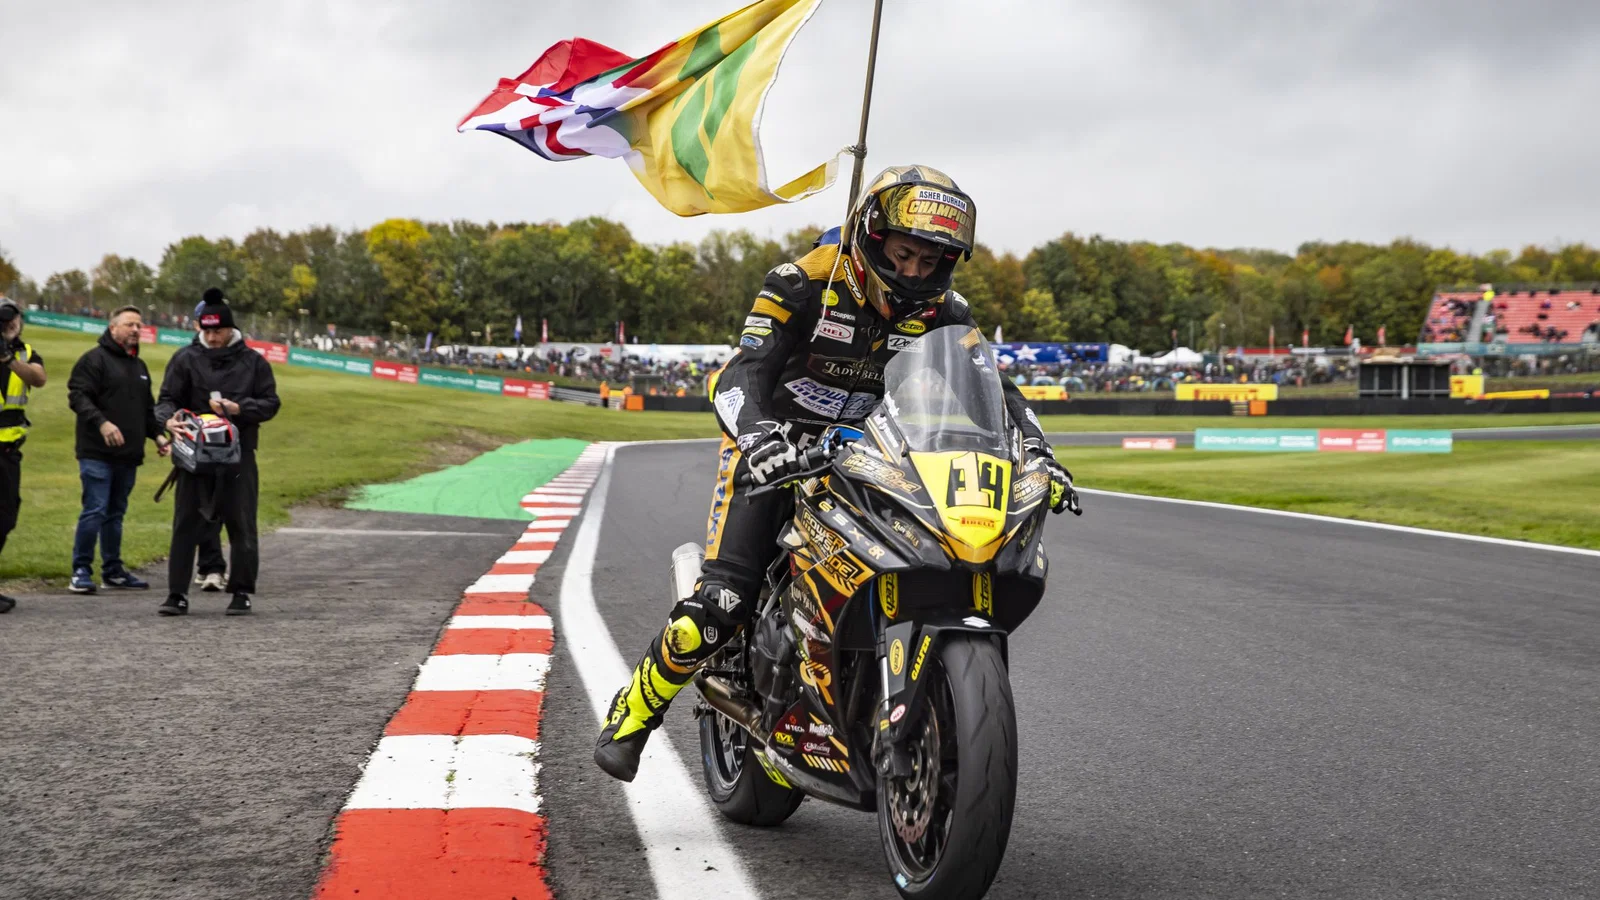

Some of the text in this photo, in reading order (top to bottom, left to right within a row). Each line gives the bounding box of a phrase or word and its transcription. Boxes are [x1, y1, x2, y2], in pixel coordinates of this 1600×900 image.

[919, 190, 966, 210] ASHER DURHAM
[830, 310, 856, 321] SCORPION
[823, 327, 843, 337] HEL
[1013, 471, 1042, 493] POWER
[707, 448, 733, 545] SUZUKI
[803, 511, 844, 549] POWER
[961, 517, 995, 528] PIRELLI
[911, 634, 932, 682] GALFER
